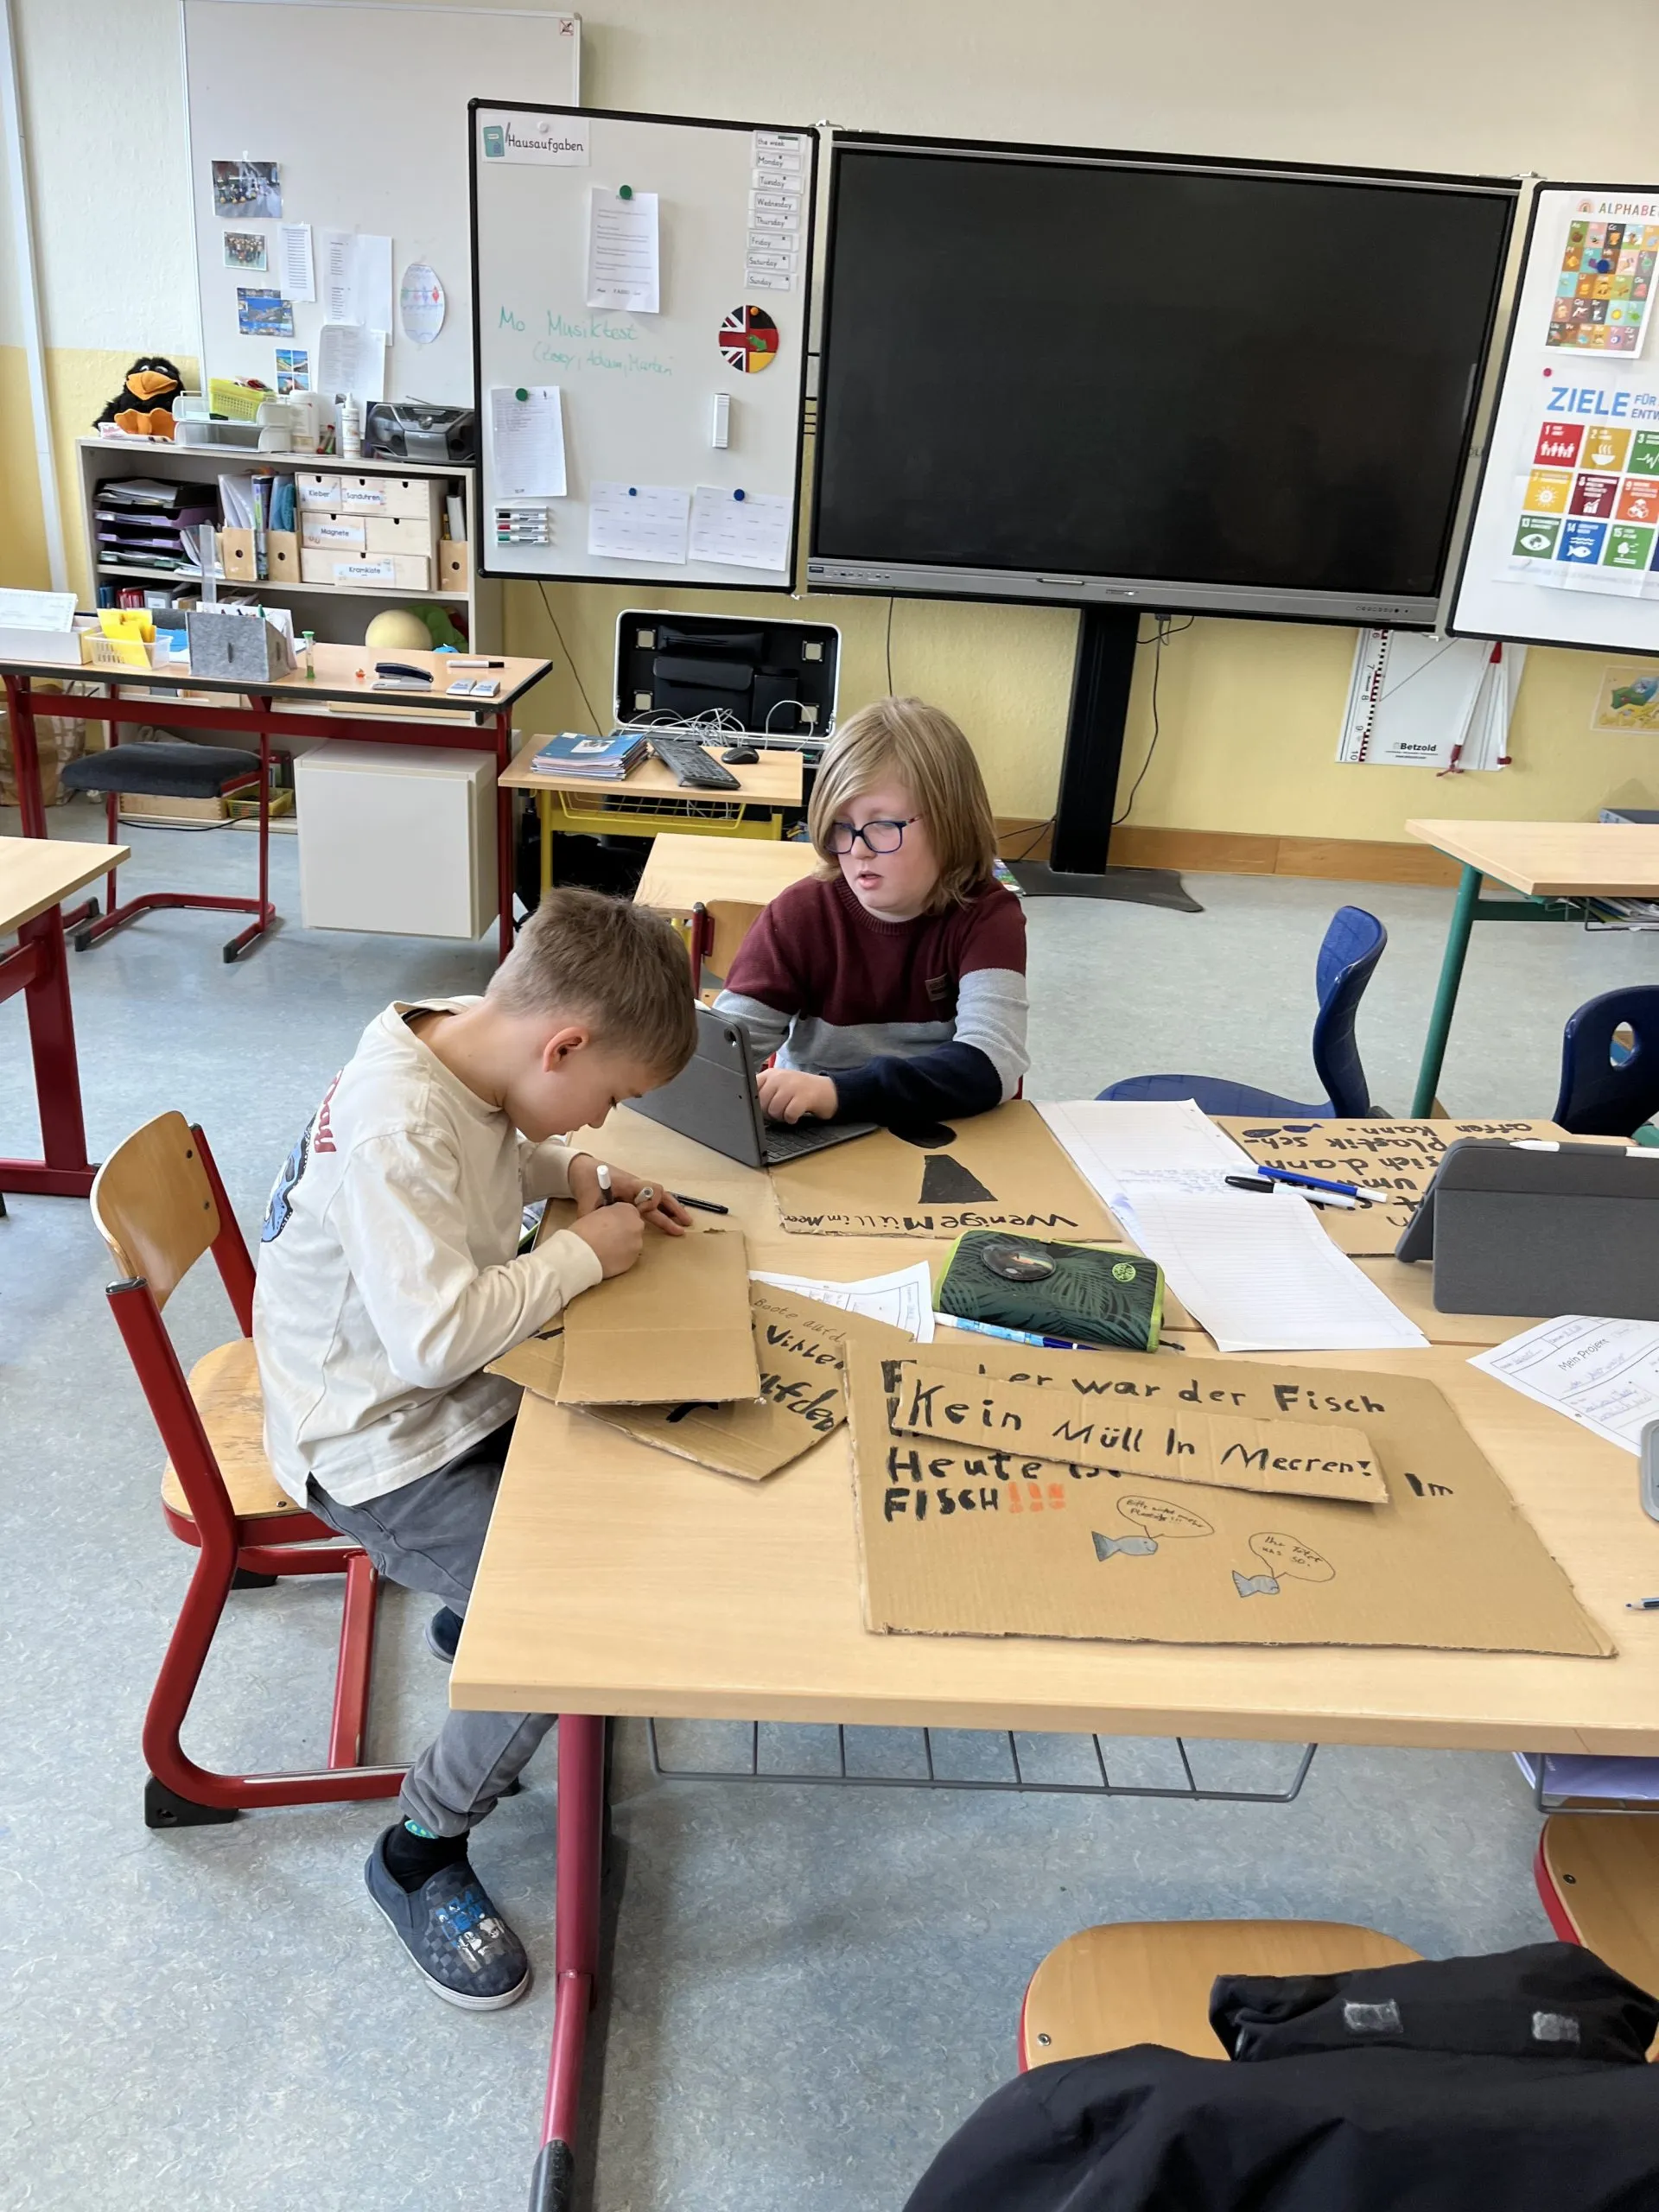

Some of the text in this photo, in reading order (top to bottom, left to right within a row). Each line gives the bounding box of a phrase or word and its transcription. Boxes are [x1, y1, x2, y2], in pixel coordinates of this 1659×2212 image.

[508, 134, 584, 154] Hausaufgaben
[758, 156, 783, 168] Monday
[760, 175, 785, 189] Tuesday
[757, 198, 792, 210] Wednesday
[1598, 202, 1659, 217] ALPHABE
[756, 216, 785, 228] Thursday
[751, 236, 772, 249] Friday
[748, 257, 778, 269] Saturday
[748, 276, 772, 289] Sunday
[499, 305, 638, 340] Mo Musiktest
[1547, 386, 1657, 416] ZIELE FÜR
[308, 489, 331, 499] Kleber
[346, 492, 381, 501] Sanduhren
[320, 527, 350, 537] Magnete
[348, 566, 381, 575] Kramkiste
[1400, 742, 1437, 752] Betzold
[1325, 1128, 1448, 1154] Plastik
[1263, 1158, 1369, 1176] dann
[784, 1212, 1079, 1230] Wenige Müll im Meer
[753, 1298, 799, 1319] Boote
[1557, 1352, 1580, 1372] Mein
[1576, 1338, 1611, 1361] Projekt
[1071, 1377, 1161, 1397] war
[1178, 1378, 1246, 1407] der
[1273, 1383, 1386, 1413] Fisch
[907, 1378, 1022, 1431] Kein
[1051, 1419, 1143, 1453] Müll
[886, 1446, 1043, 1485] Heute
